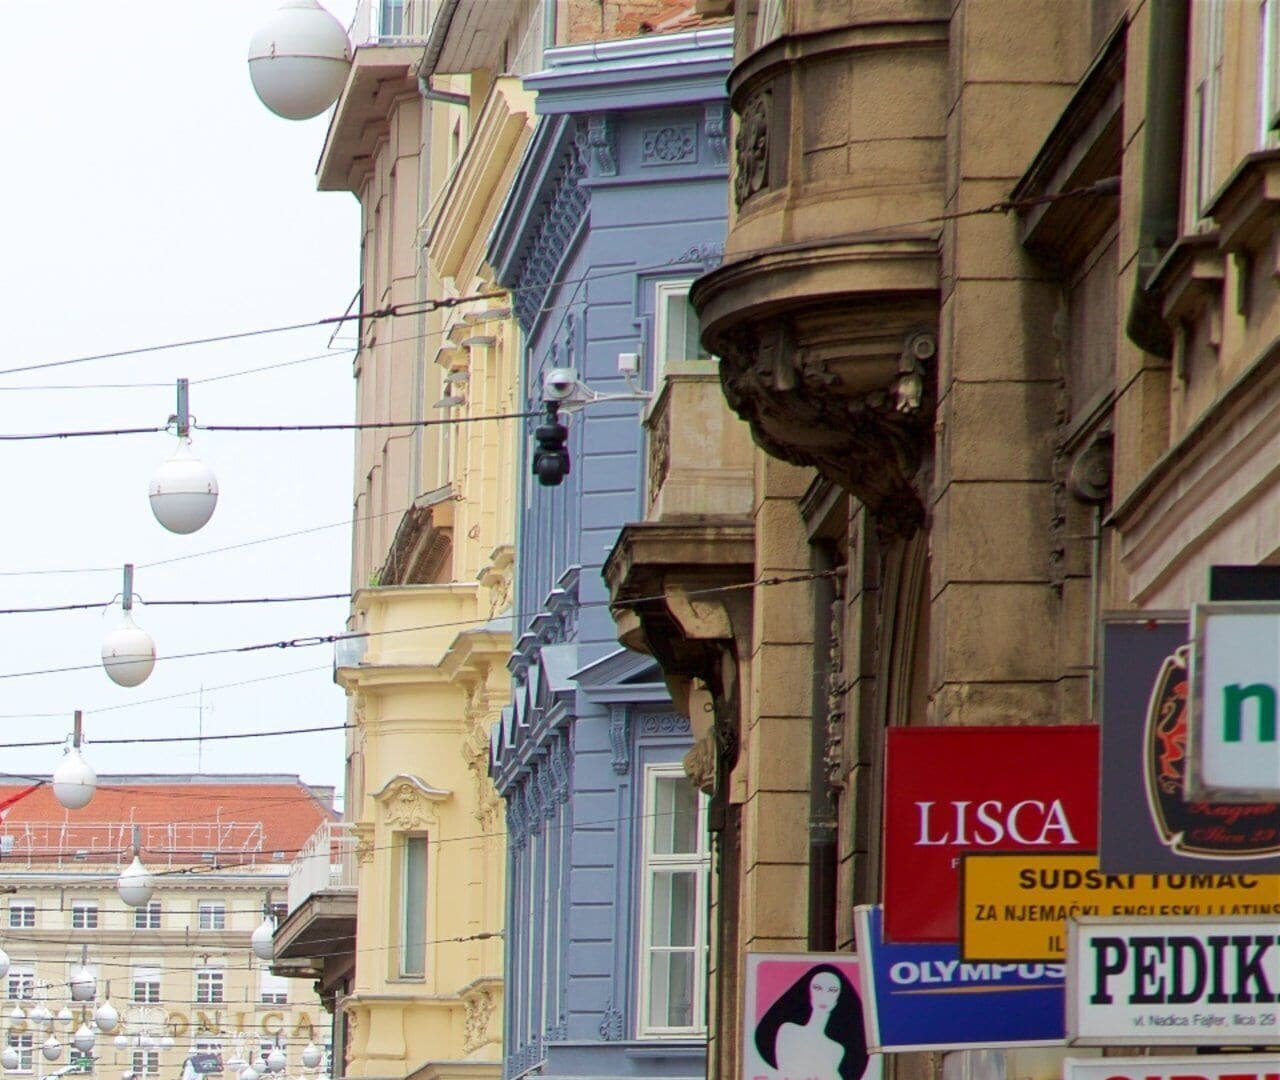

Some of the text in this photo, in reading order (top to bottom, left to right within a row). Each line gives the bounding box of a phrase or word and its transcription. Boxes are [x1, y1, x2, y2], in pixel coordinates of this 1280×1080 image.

[914, 799, 1080, 846] LISCA
[975, 905, 997, 921] ZA
[1089, 935, 1280, 1005] PEDIK
